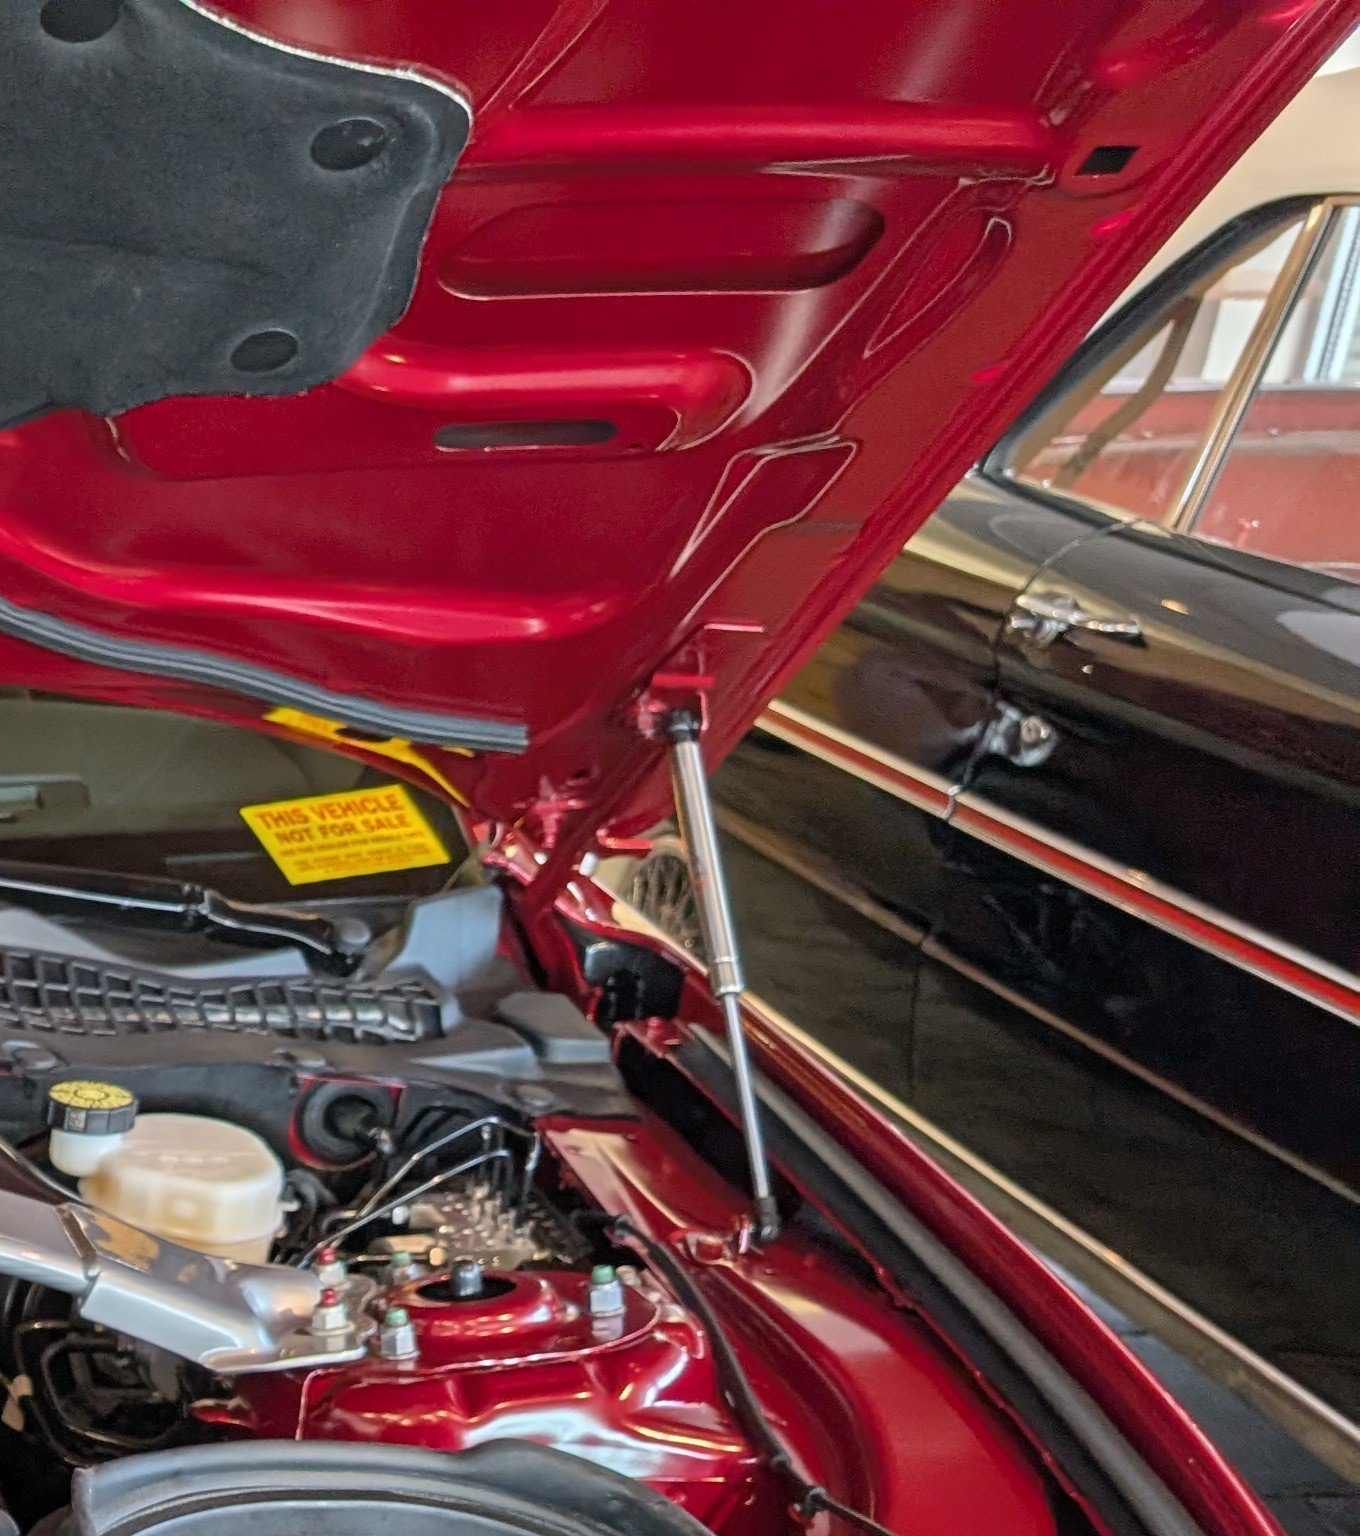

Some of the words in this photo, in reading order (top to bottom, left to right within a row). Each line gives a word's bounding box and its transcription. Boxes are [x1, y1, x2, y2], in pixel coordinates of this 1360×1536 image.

[255, 807, 309, 829] THIS
[310, 793, 404, 820] VEHICLE
[275, 828, 315, 845] NOT
[318, 821, 358, 839] FOR
[361, 813, 410, 831] SALE
